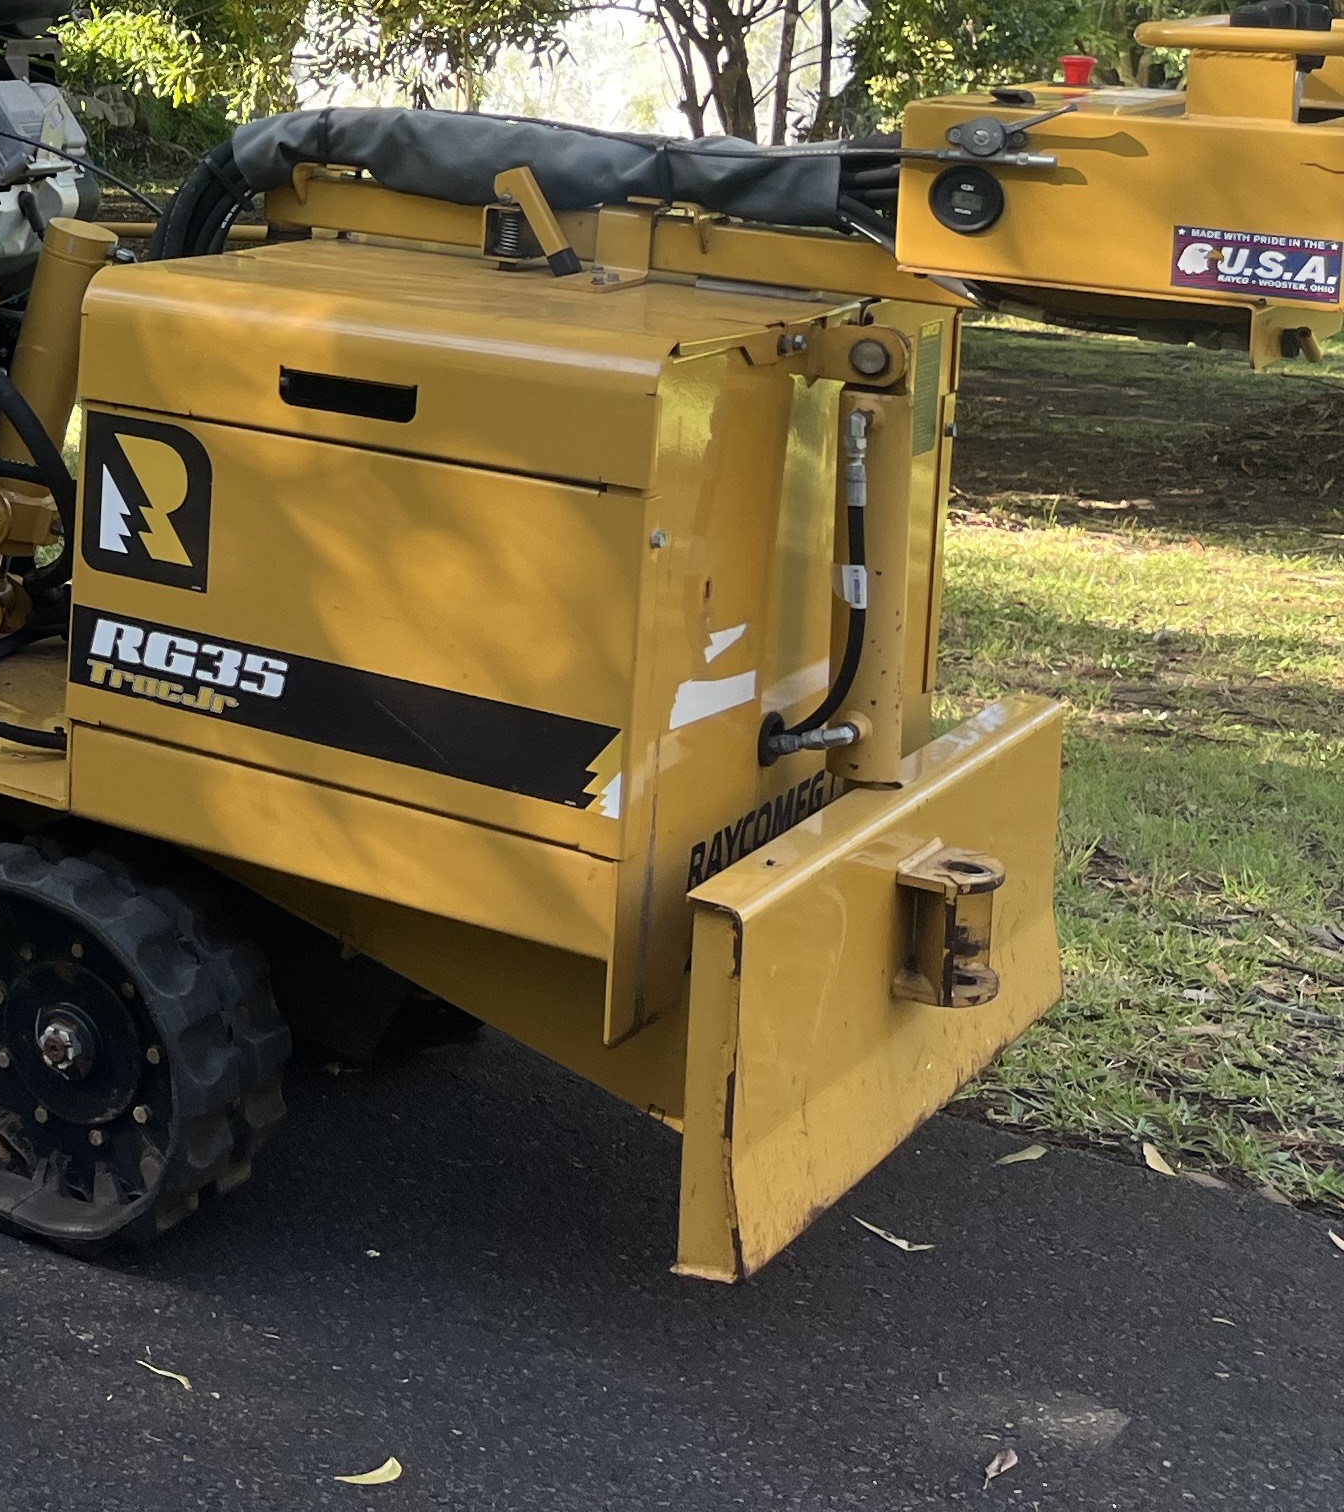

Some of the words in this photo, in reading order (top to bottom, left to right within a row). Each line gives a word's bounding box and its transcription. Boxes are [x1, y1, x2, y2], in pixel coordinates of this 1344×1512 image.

[1191, 228, 1221, 239] MADE
[1224, 232, 1251, 243] WITH
[1254, 235, 1286, 247] PRIDE
[1289, 239, 1301, 248] IN
[1304, 241, 1326, 250] THE
[1217, 246, 1338, 285] U.S.A.
[1217, 274, 1250, 285] RAYCO
[1258, 278, 1309, 292] WOOSTER,
[1309, 285, 1335, 294] OHIO
[89, 617, 289, 700] RG35
